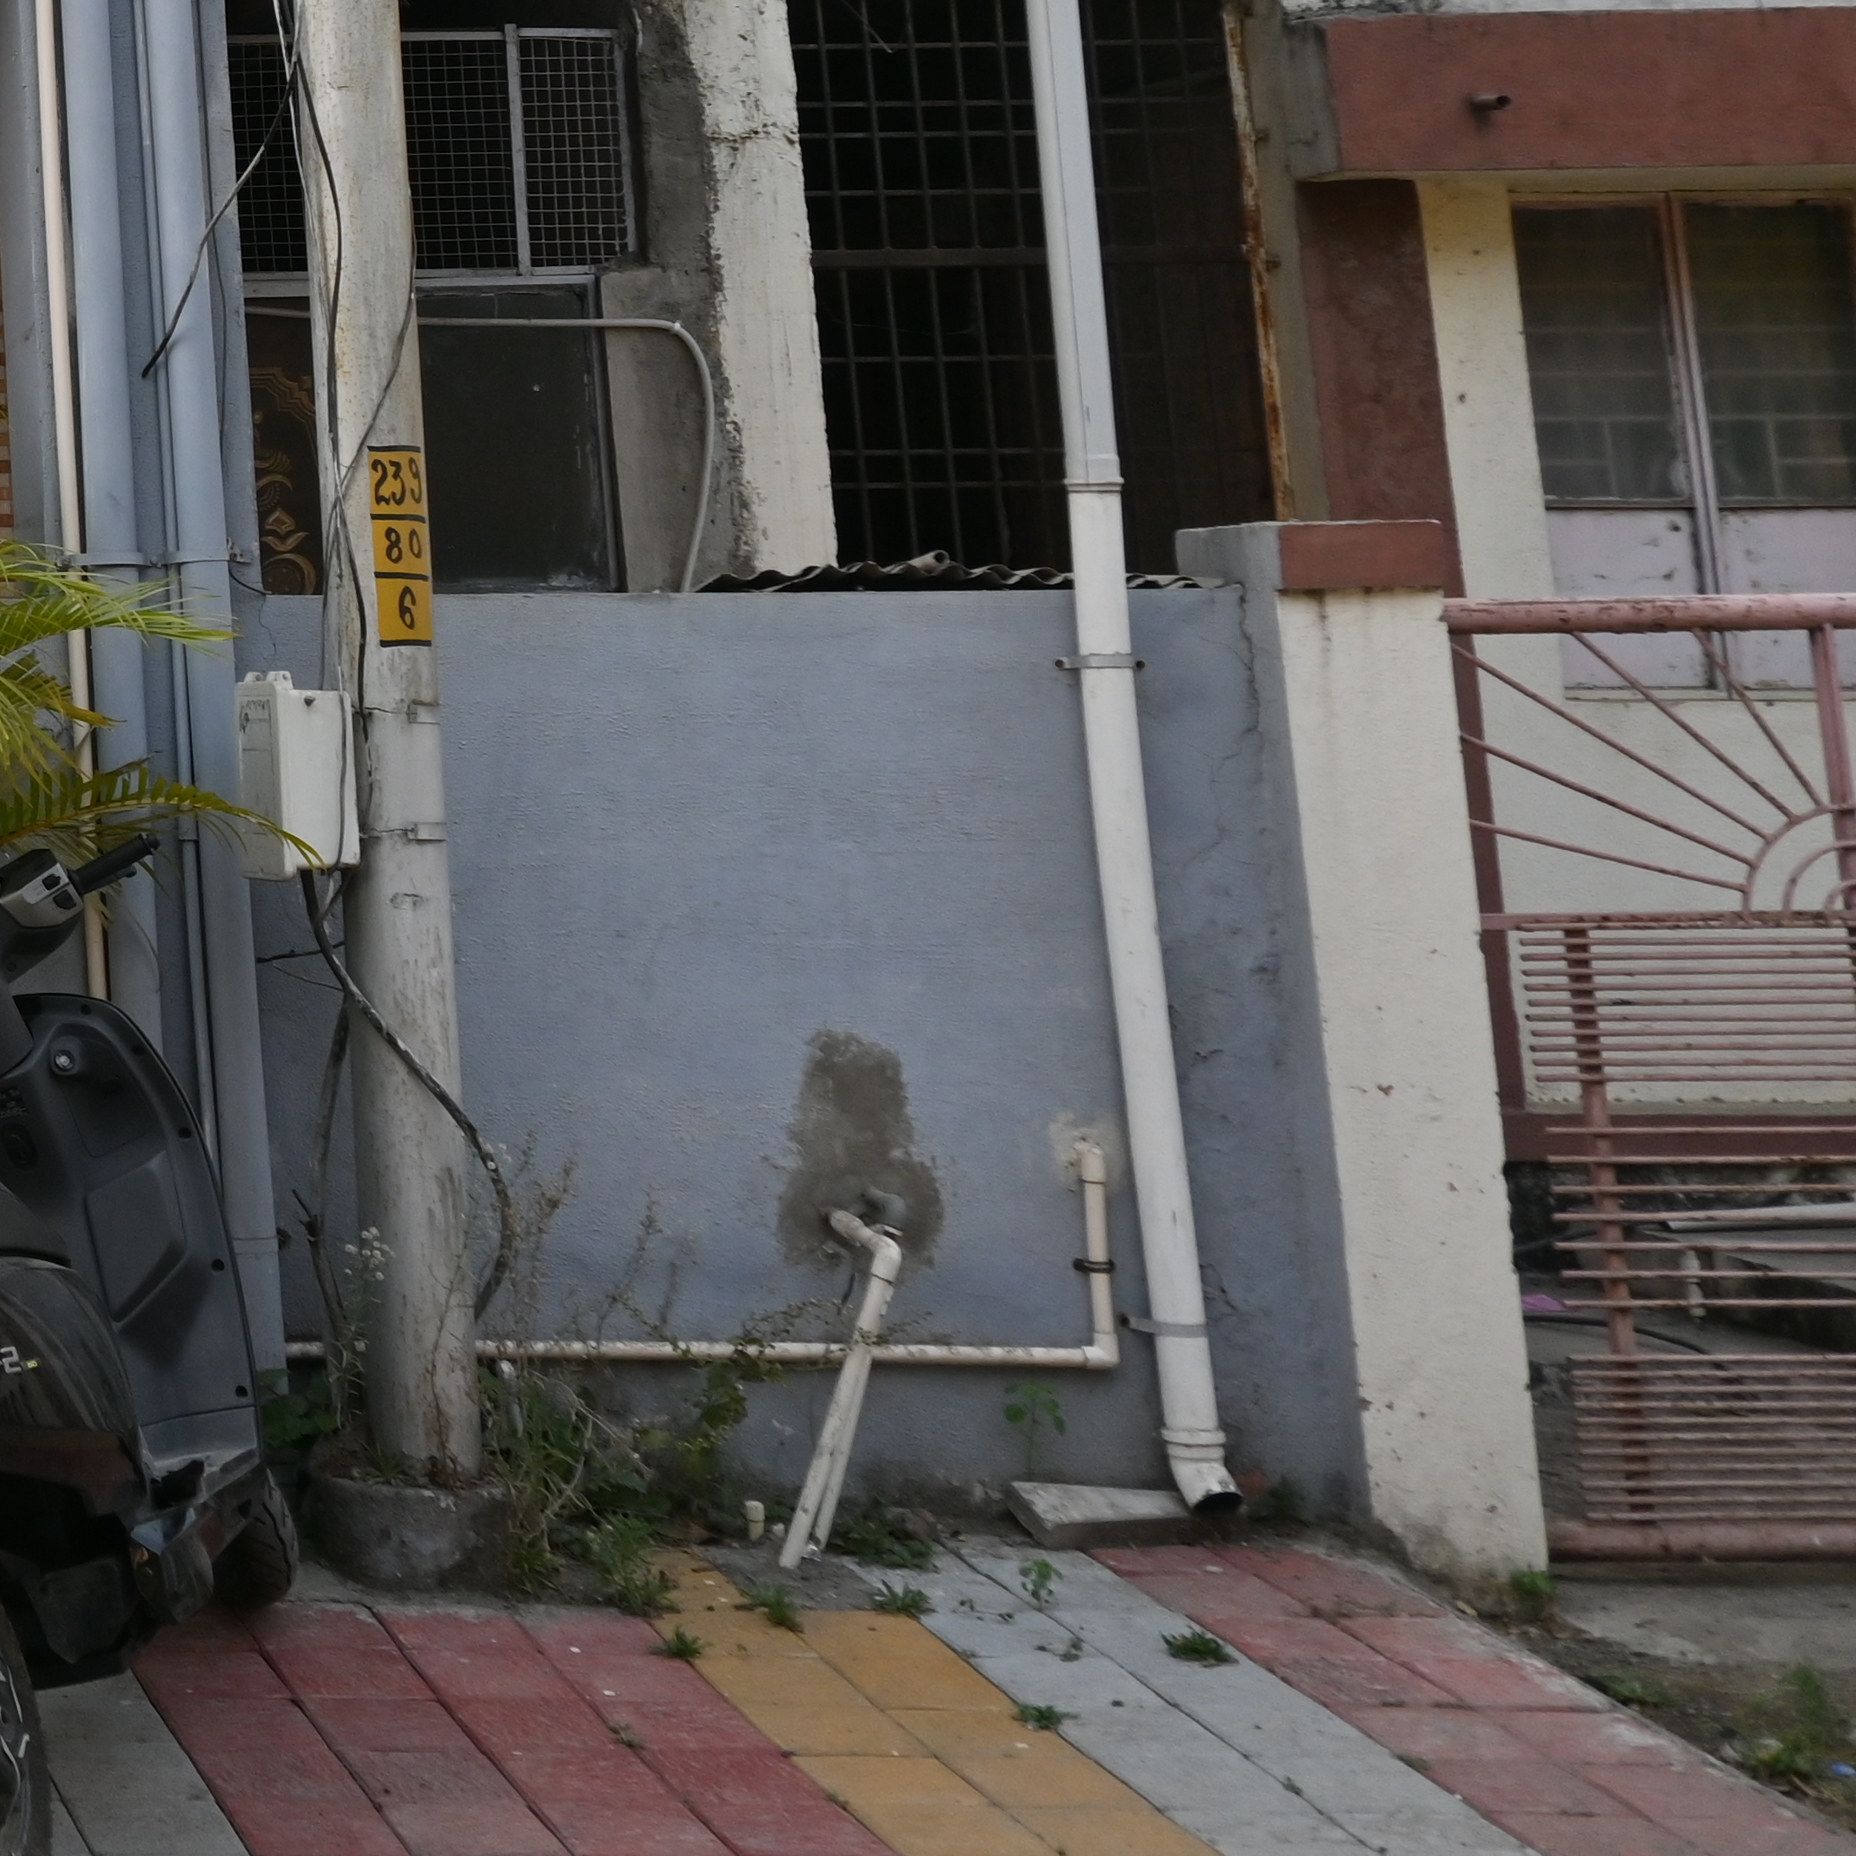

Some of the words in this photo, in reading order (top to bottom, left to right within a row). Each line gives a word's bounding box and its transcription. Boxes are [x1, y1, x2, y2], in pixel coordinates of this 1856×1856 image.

[372, 456, 422, 505] 239
[385, 527, 422, 564] 80
[399, 585, 416, 630] 6
